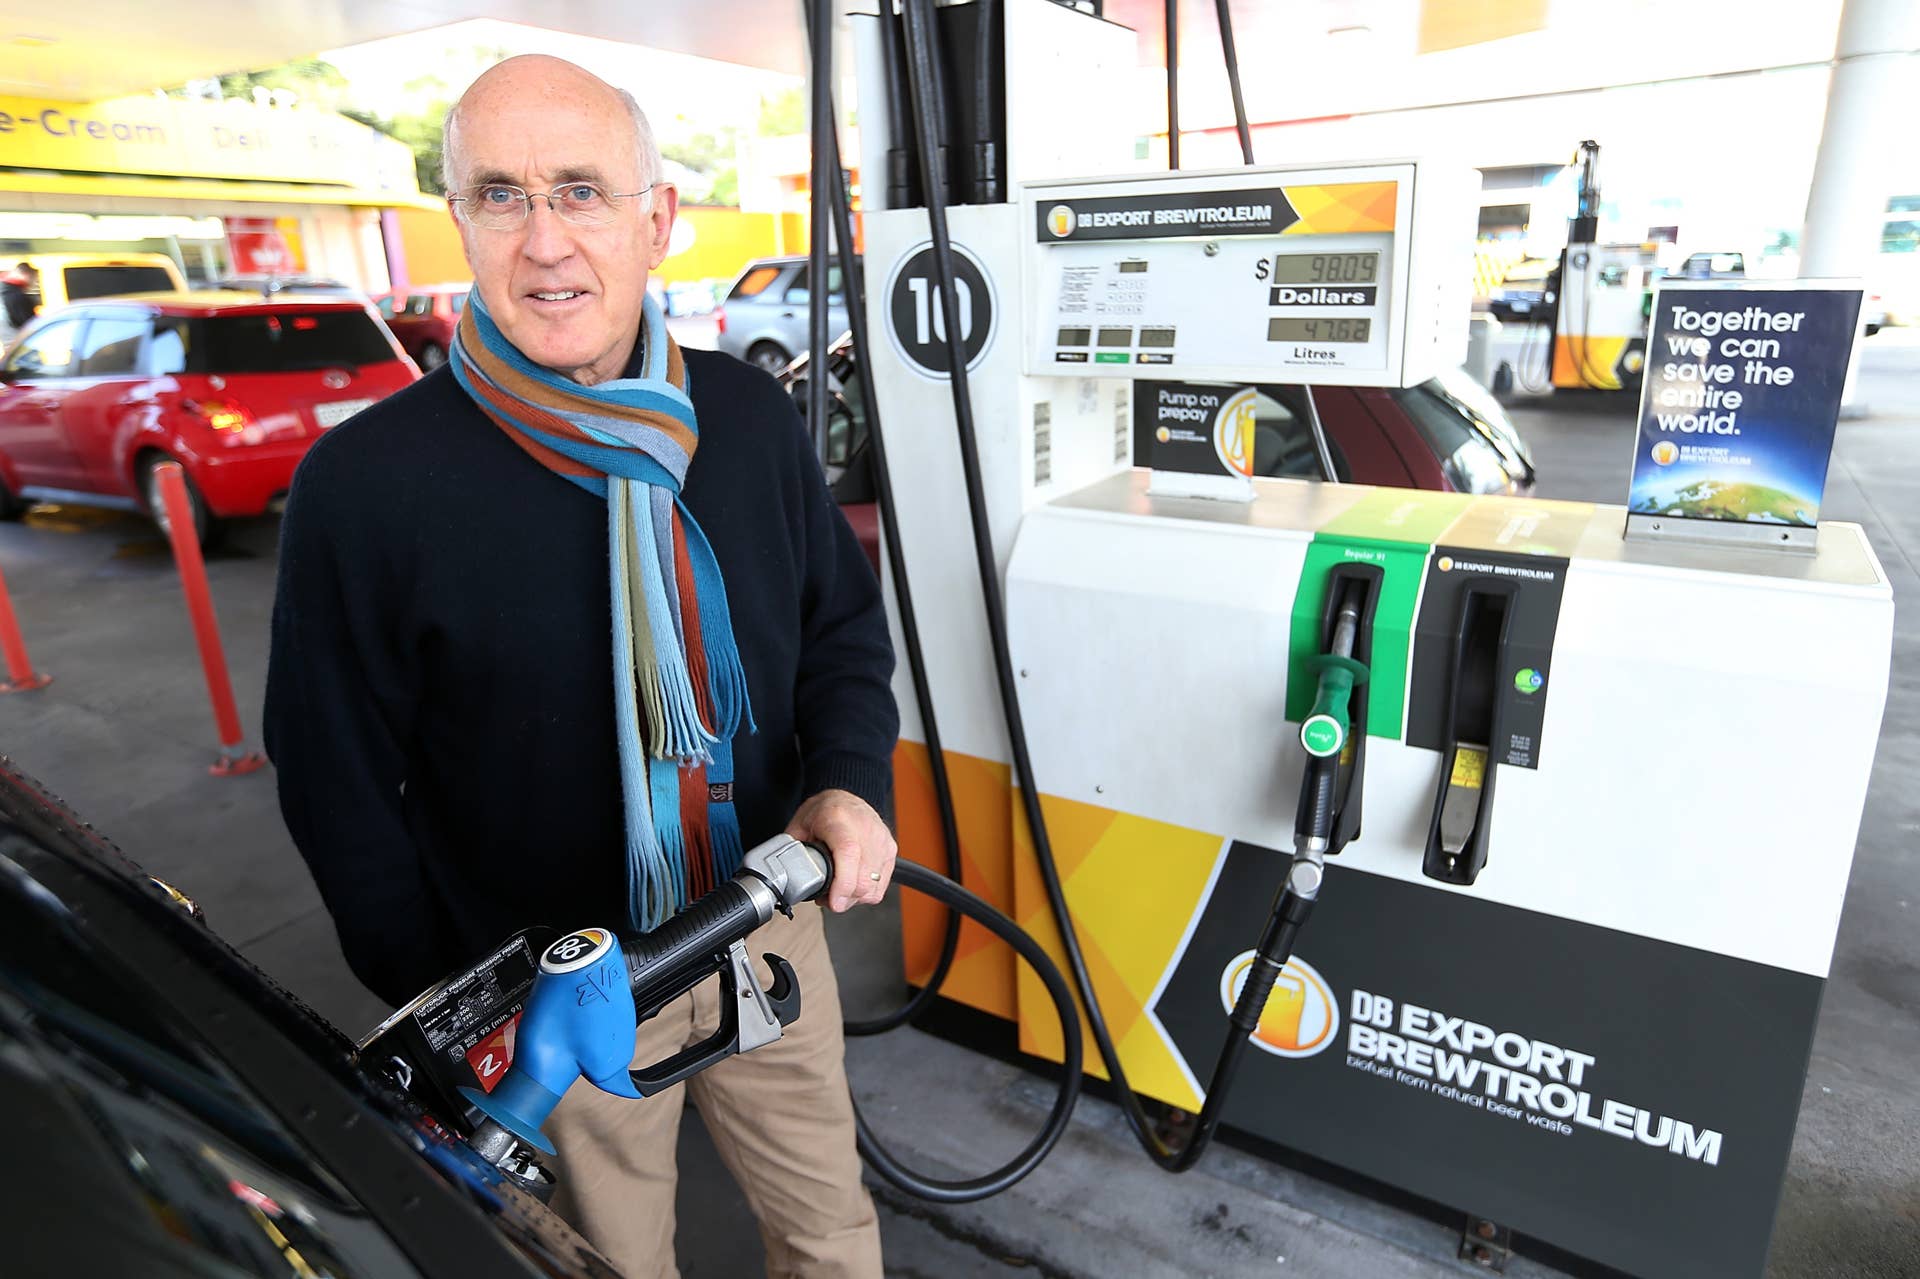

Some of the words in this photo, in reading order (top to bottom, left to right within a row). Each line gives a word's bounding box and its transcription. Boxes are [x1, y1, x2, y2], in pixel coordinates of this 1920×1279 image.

[1093, 210, 1153, 227] EXPORT
[1153, 205, 1272, 225] BREWTROLEUM
[1255, 258, 1270, 281] $
[1278, 288, 1366, 304] Dollars
[1671, 305, 1806, 336] Together
[1294, 347, 1337, 359] Litres
[1667, 337, 1711, 357] we
[1720, 338, 1781, 359] can
[1663, 362, 1735, 384] save
[1744, 360, 1795, 387] the
[1158, 389, 1199, 408] Pump
[1200, 395, 1219, 407] on
[1659, 385, 1743, 410] entire
[1158, 406, 1209, 424] prepay
[1657, 411, 1741, 436] world.
[1463, 562, 1494, 573] EXPORT
[1494, 565, 1554, 580] BREWTROLEUM
[448, 971, 476, 993] PRESSURE
[1350, 988, 1393, 1029] DB
[1401, 1003, 1595, 1086] EXPORT
[1346, 1055, 1394, 1079] biofuel
[1396, 1069, 1430, 1091] from
[1431, 1082, 1484, 1108] natural
[1486, 1097, 1523, 1120] beer
[1526, 1112, 1574, 1136] waste
[1347, 1022, 1723, 1166] BREWTROLEUM
